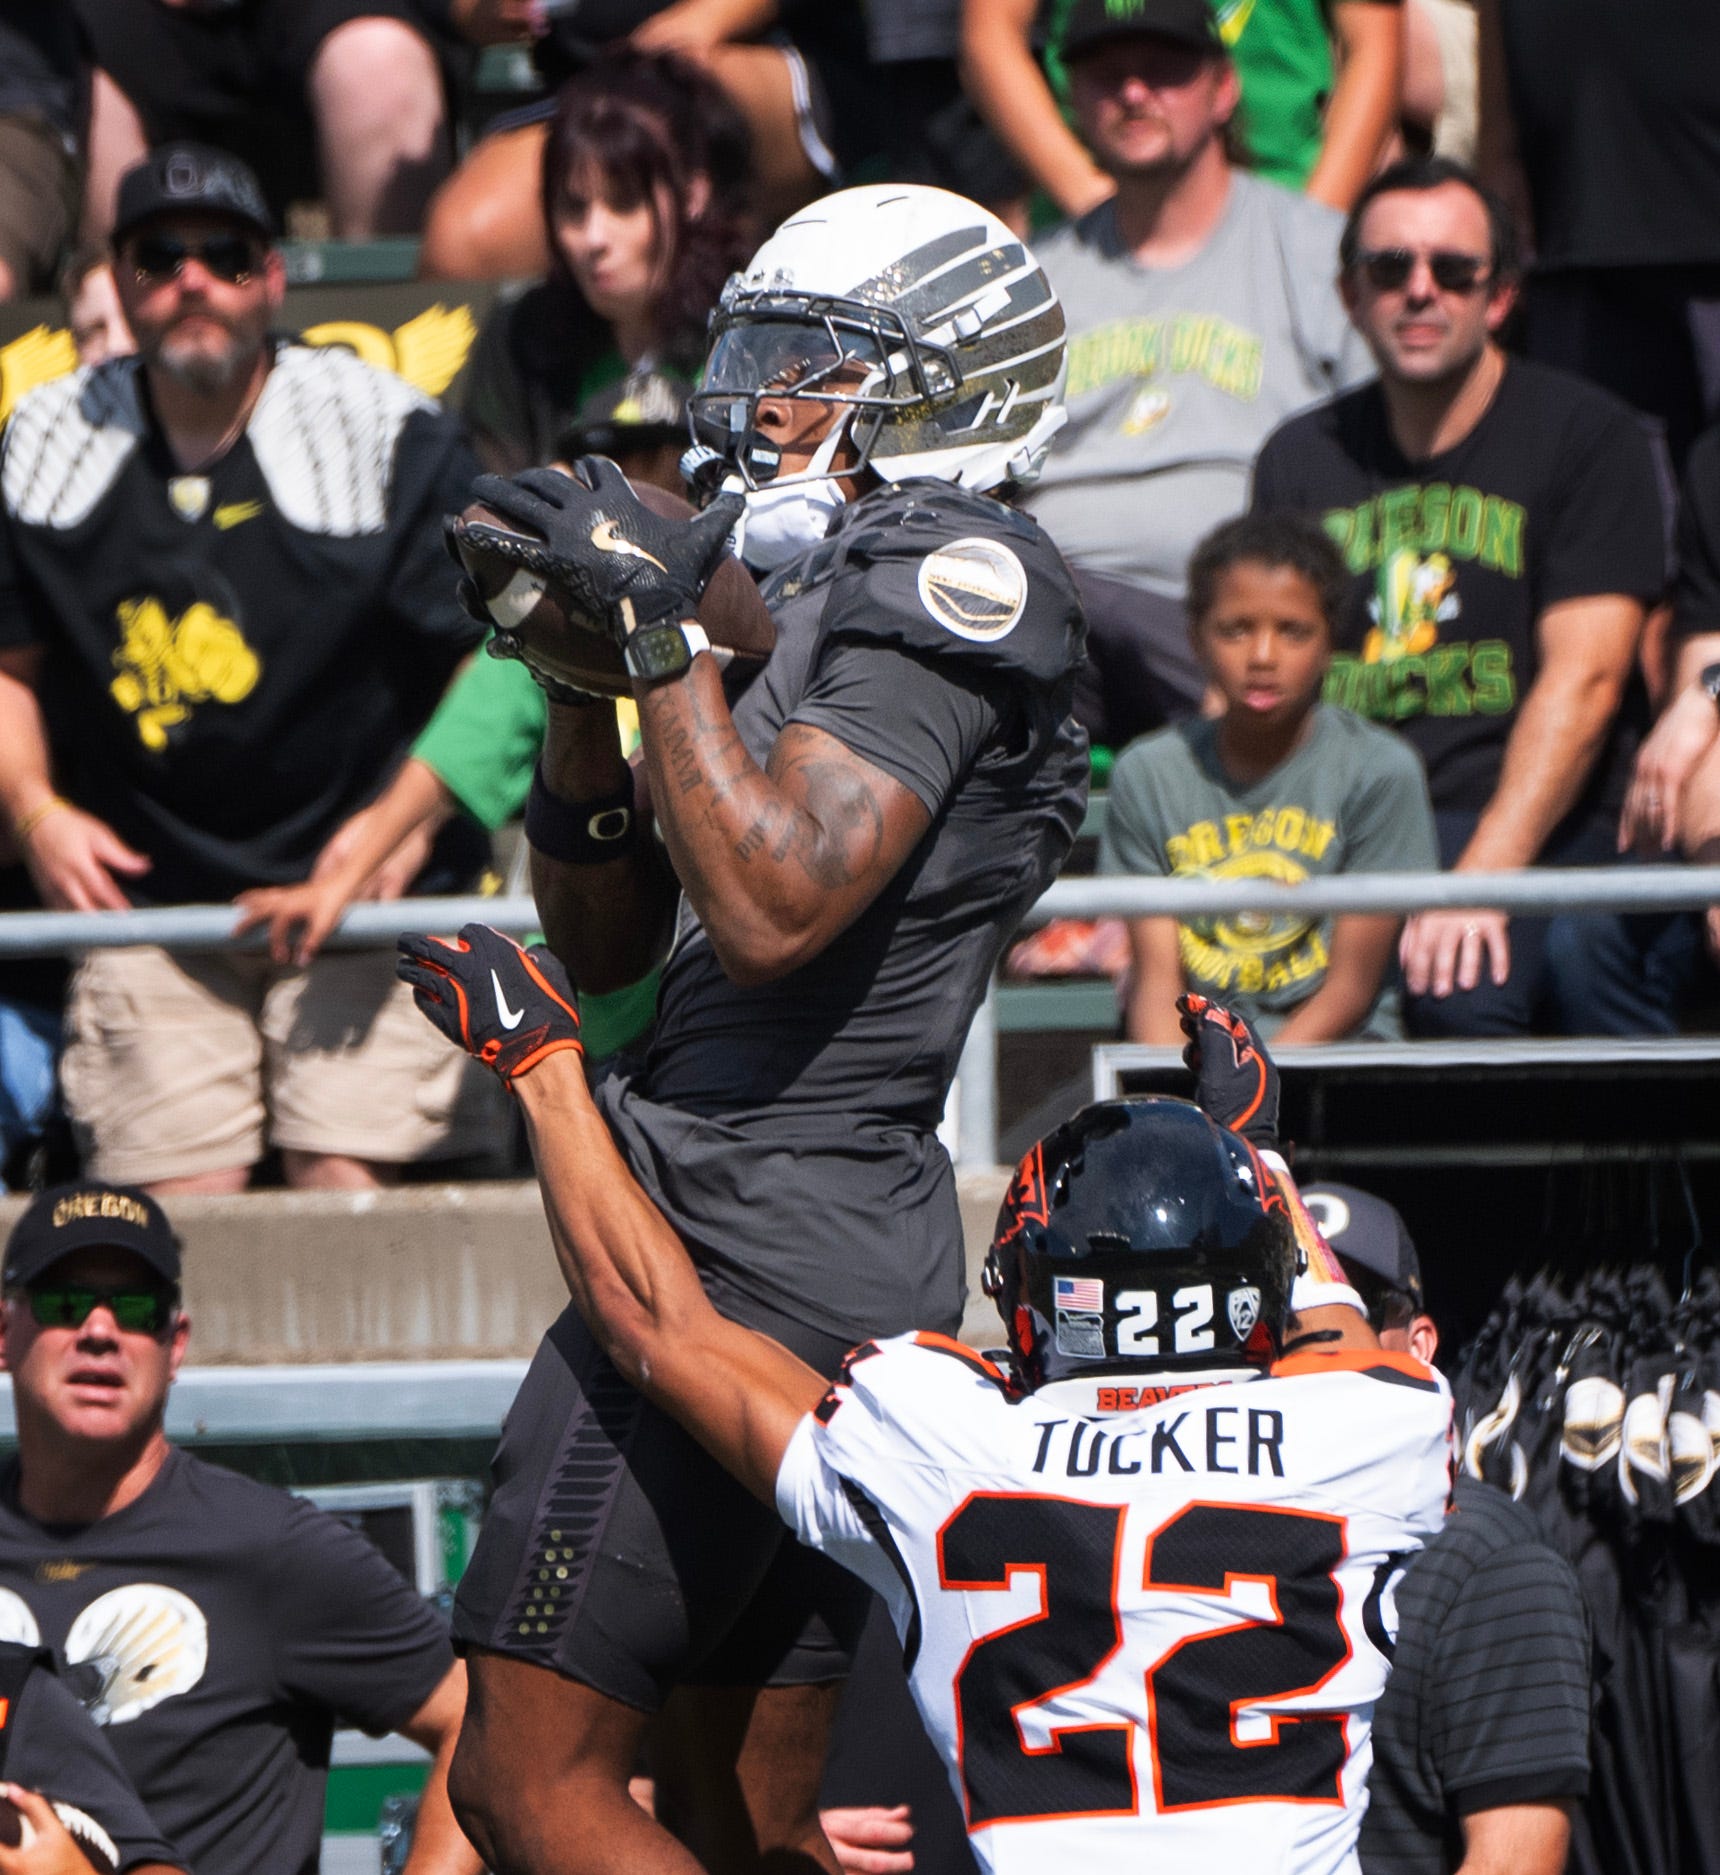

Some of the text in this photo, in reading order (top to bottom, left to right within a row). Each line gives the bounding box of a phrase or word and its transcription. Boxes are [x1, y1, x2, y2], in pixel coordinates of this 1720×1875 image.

[53, 1192, 148, 1228] OREGON
[1115, 1284, 1215, 1355] 22
[1097, 1380, 1233, 1412] BEAV
[1032, 1406, 1285, 1478] TUCKER
[936, 1490, 1354, 1835] 22
